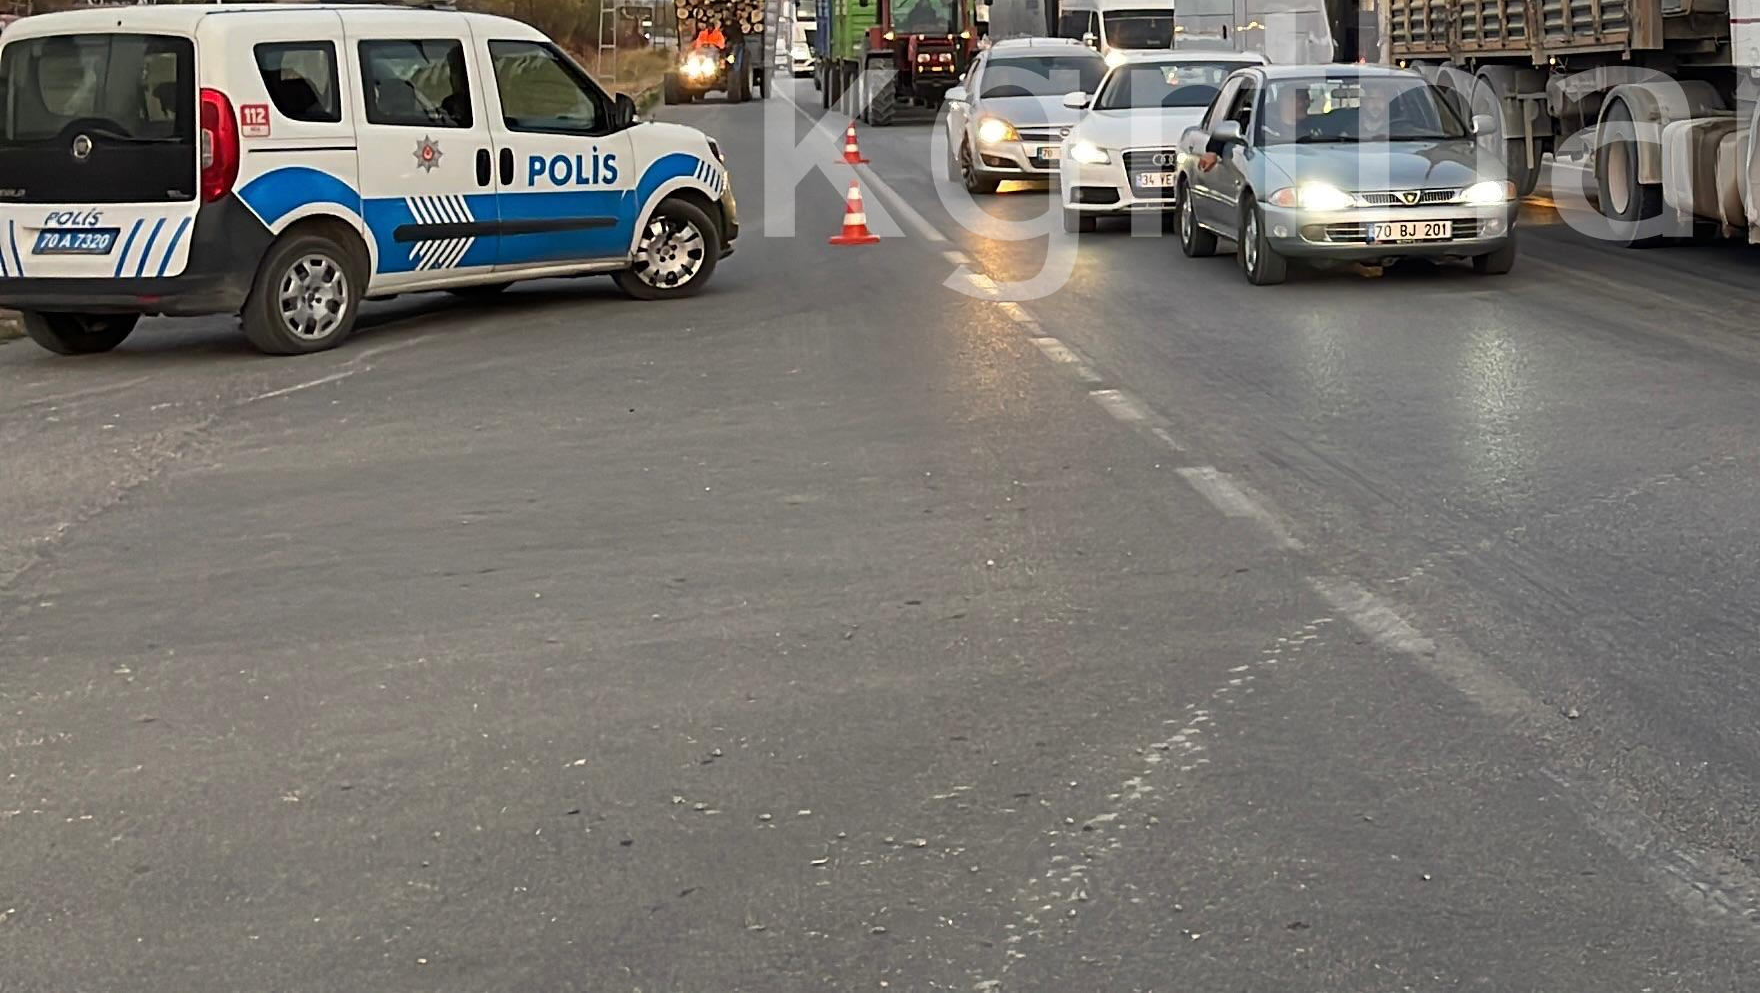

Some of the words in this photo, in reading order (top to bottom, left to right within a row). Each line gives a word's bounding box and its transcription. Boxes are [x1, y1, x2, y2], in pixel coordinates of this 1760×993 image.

[244, 107, 267, 124] 112
[1042, 149, 1053, 158] 70
[528, 145, 618, 187] POLİS
[1142, 174, 1155, 185] 34
[44, 208, 104, 226] POLİS
[1375, 225, 1392, 238] 70
[1400, 224, 1416, 237] BJ
[1424, 223, 1446, 237] 201
[40, 234, 57, 248] 70
[58, 234, 71, 248] A
[75, 234, 110, 248] 7320
